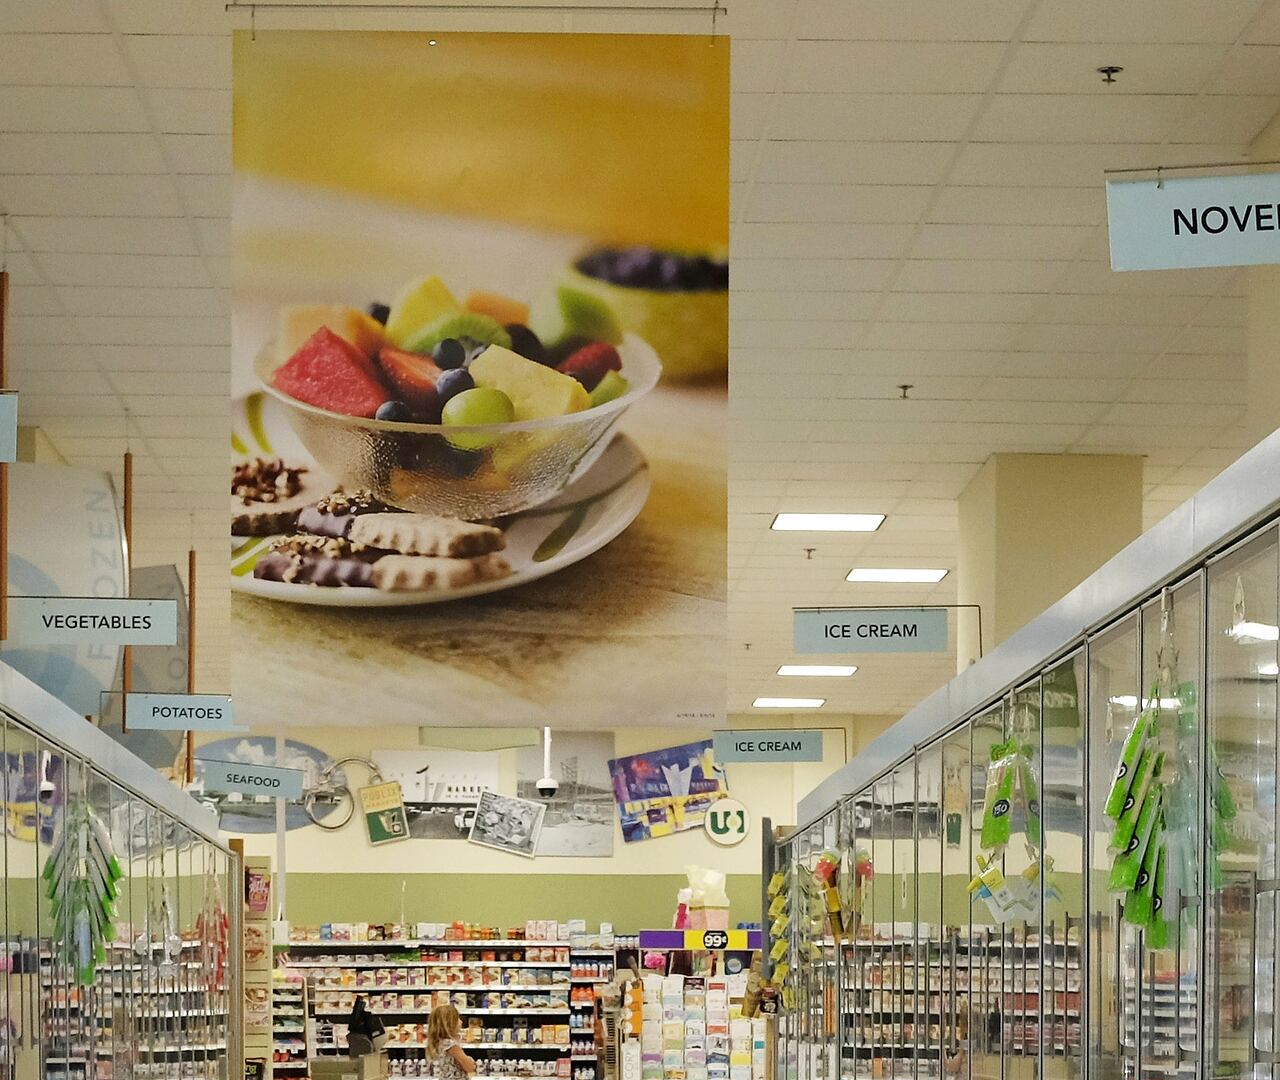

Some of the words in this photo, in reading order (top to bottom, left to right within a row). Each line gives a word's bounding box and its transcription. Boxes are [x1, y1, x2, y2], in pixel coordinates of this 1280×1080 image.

[42, 615, 152, 630] VEGETABLES
[825, 625, 851, 638] ICE
[856, 624, 918, 638] CREAM
[152, 707, 223, 720] POTATOES
[735, 742, 754, 752] ICE
[758, 741, 802, 752] CREAM
[226, 774, 281, 788] SEAFOOD
